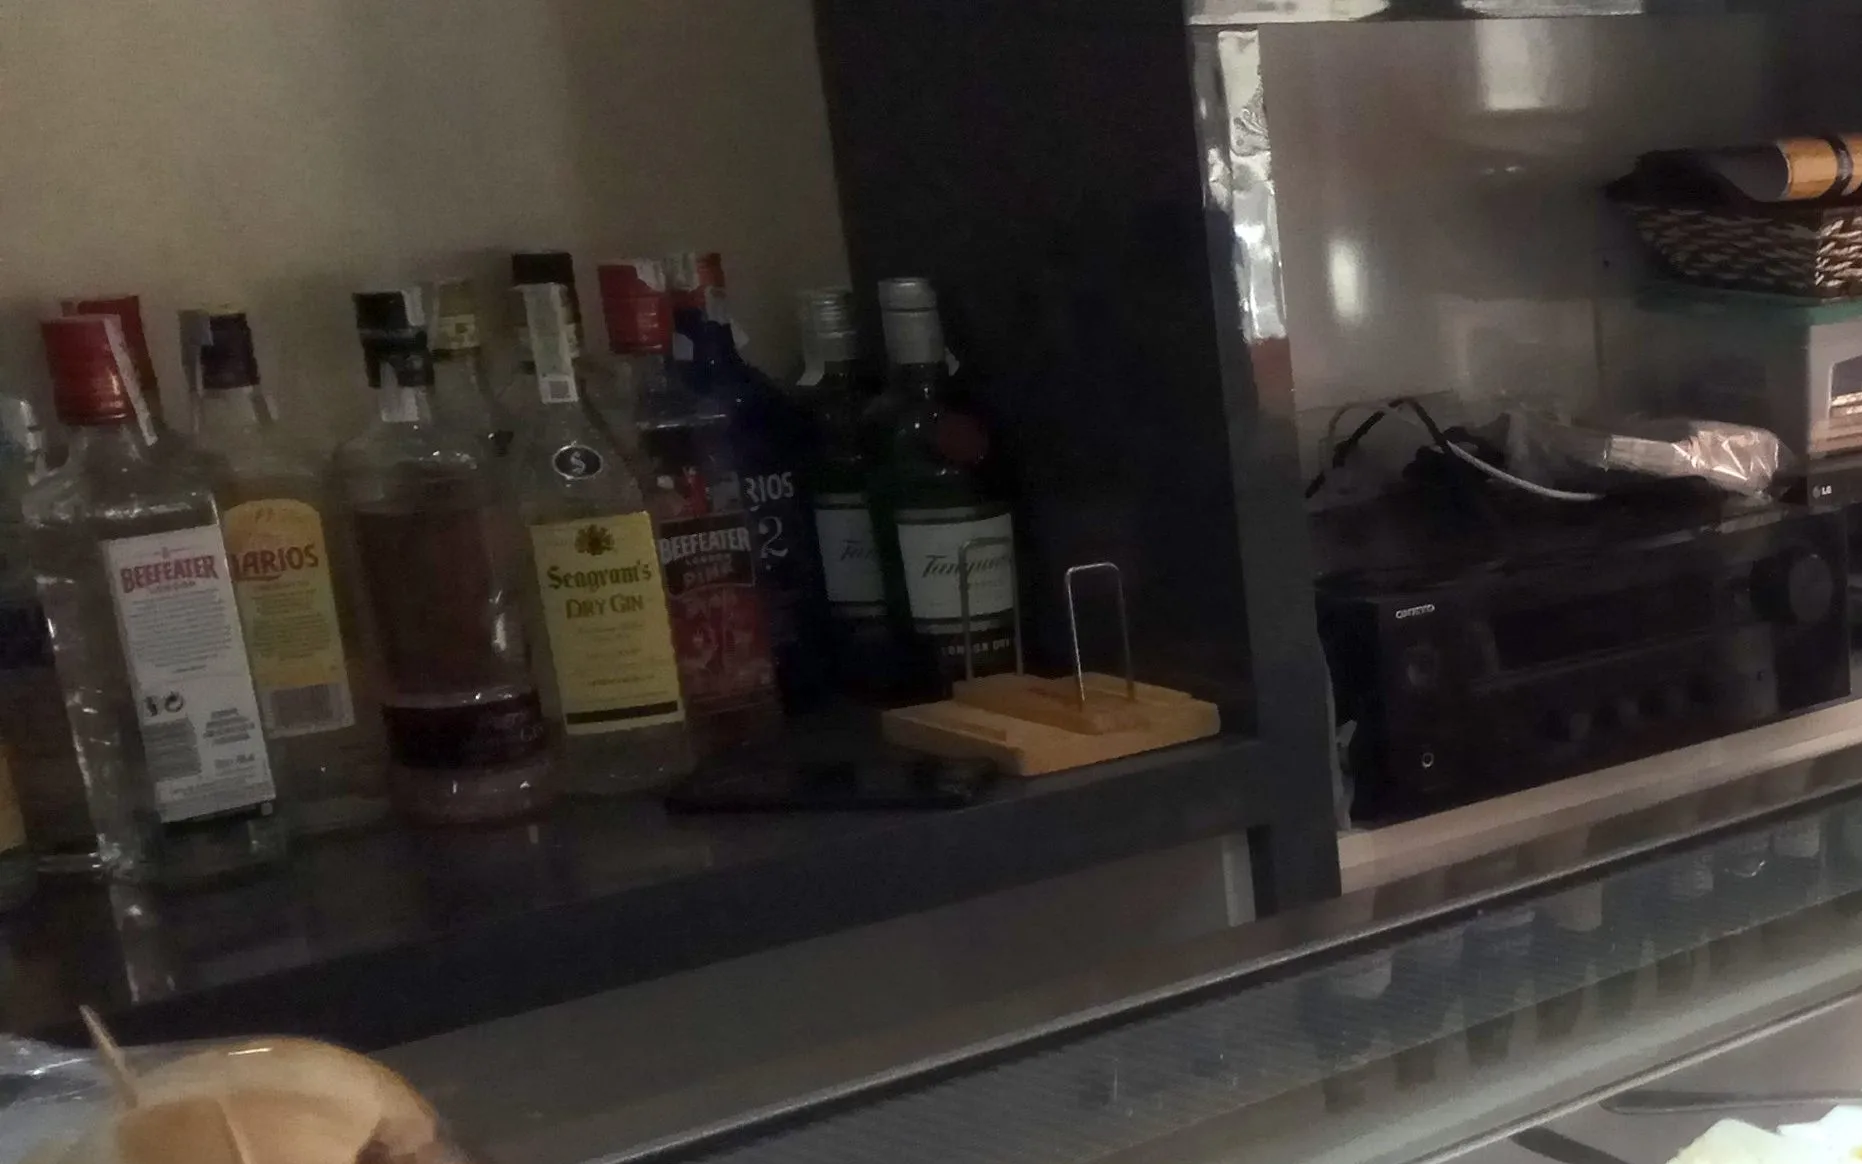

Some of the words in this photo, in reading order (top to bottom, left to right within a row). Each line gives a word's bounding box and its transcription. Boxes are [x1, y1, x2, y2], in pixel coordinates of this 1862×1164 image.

[657, 526, 752, 565] BEEFEATER
[120, 555, 219, 593] BEEFEATER
[546, 559, 652, 593] Seagram's
[565, 597, 605, 619] DRY
[609, 592, 644, 613] GIN
